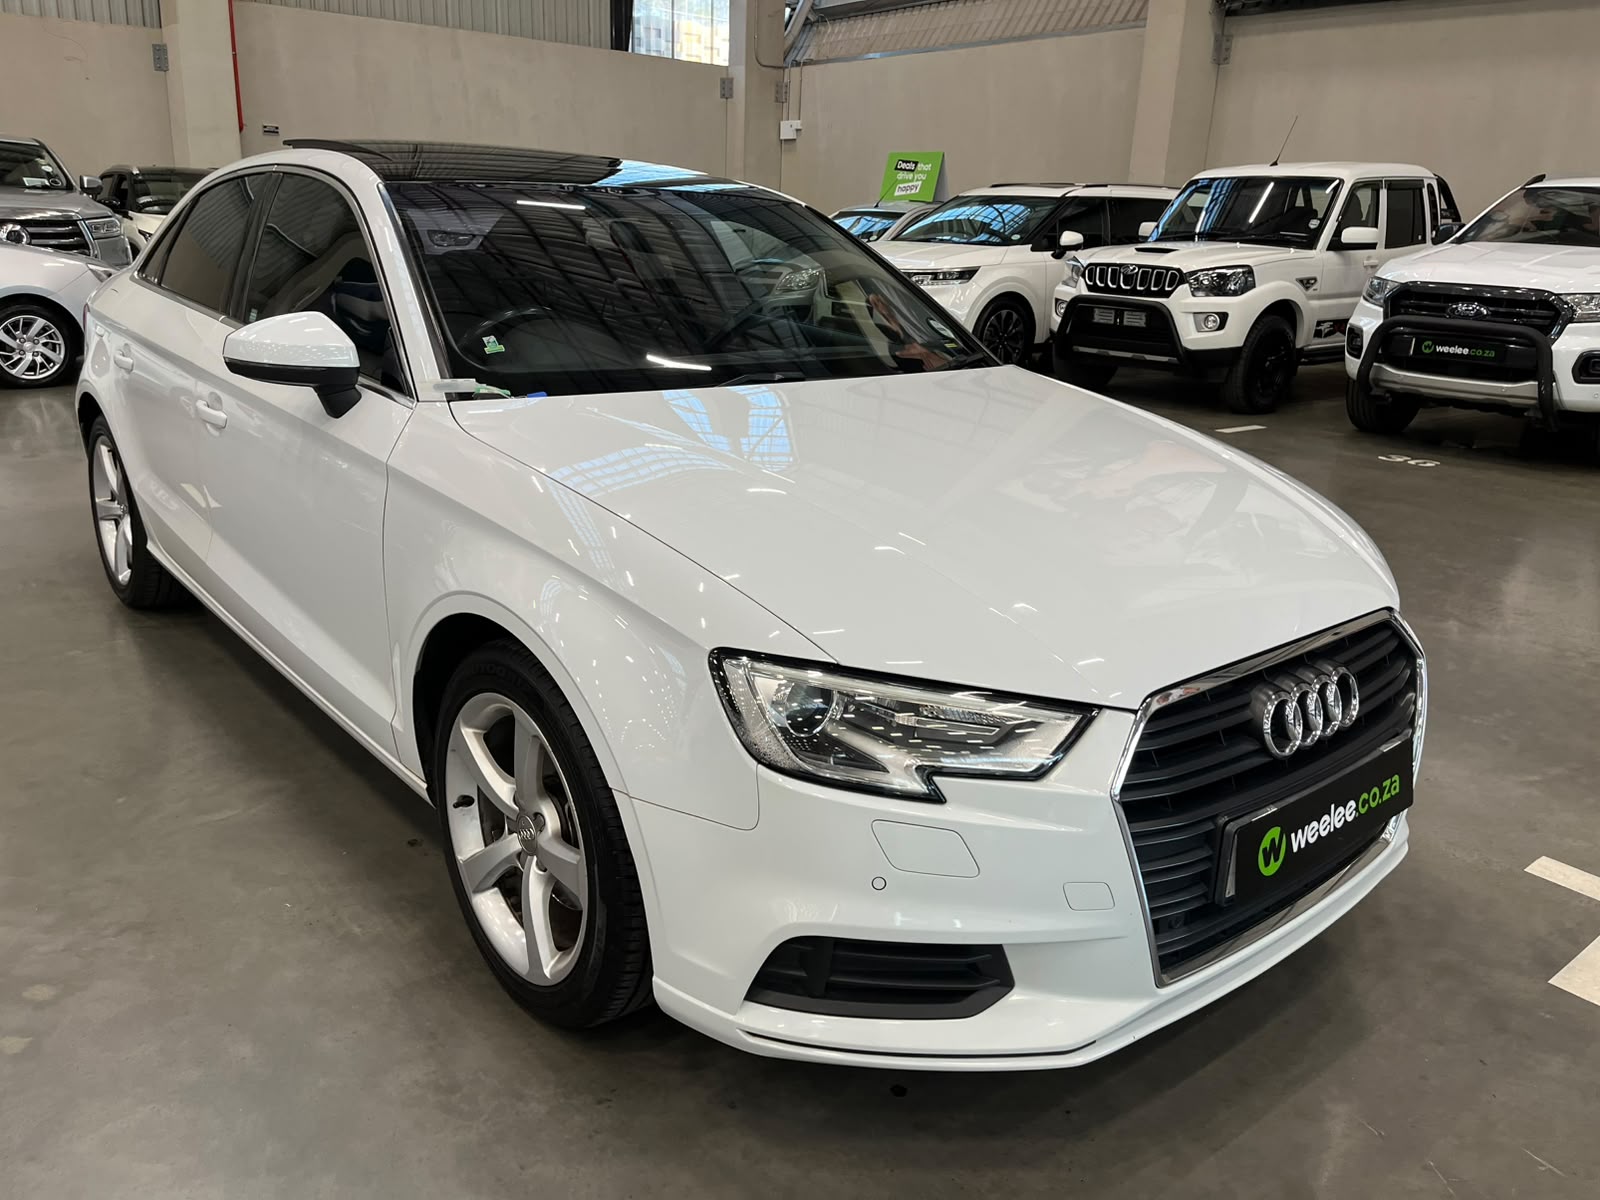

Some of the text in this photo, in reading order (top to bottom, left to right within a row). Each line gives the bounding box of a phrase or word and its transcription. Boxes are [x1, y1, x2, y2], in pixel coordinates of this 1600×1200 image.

[897, 161, 932, 171] Deals that
[896, 171, 927, 183] drive you
[897, 184, 919, 194] happy
[1436, 344, 1496, 357] weelee.co.za
[1290, 774, 1400, 853] weelee.co.za
